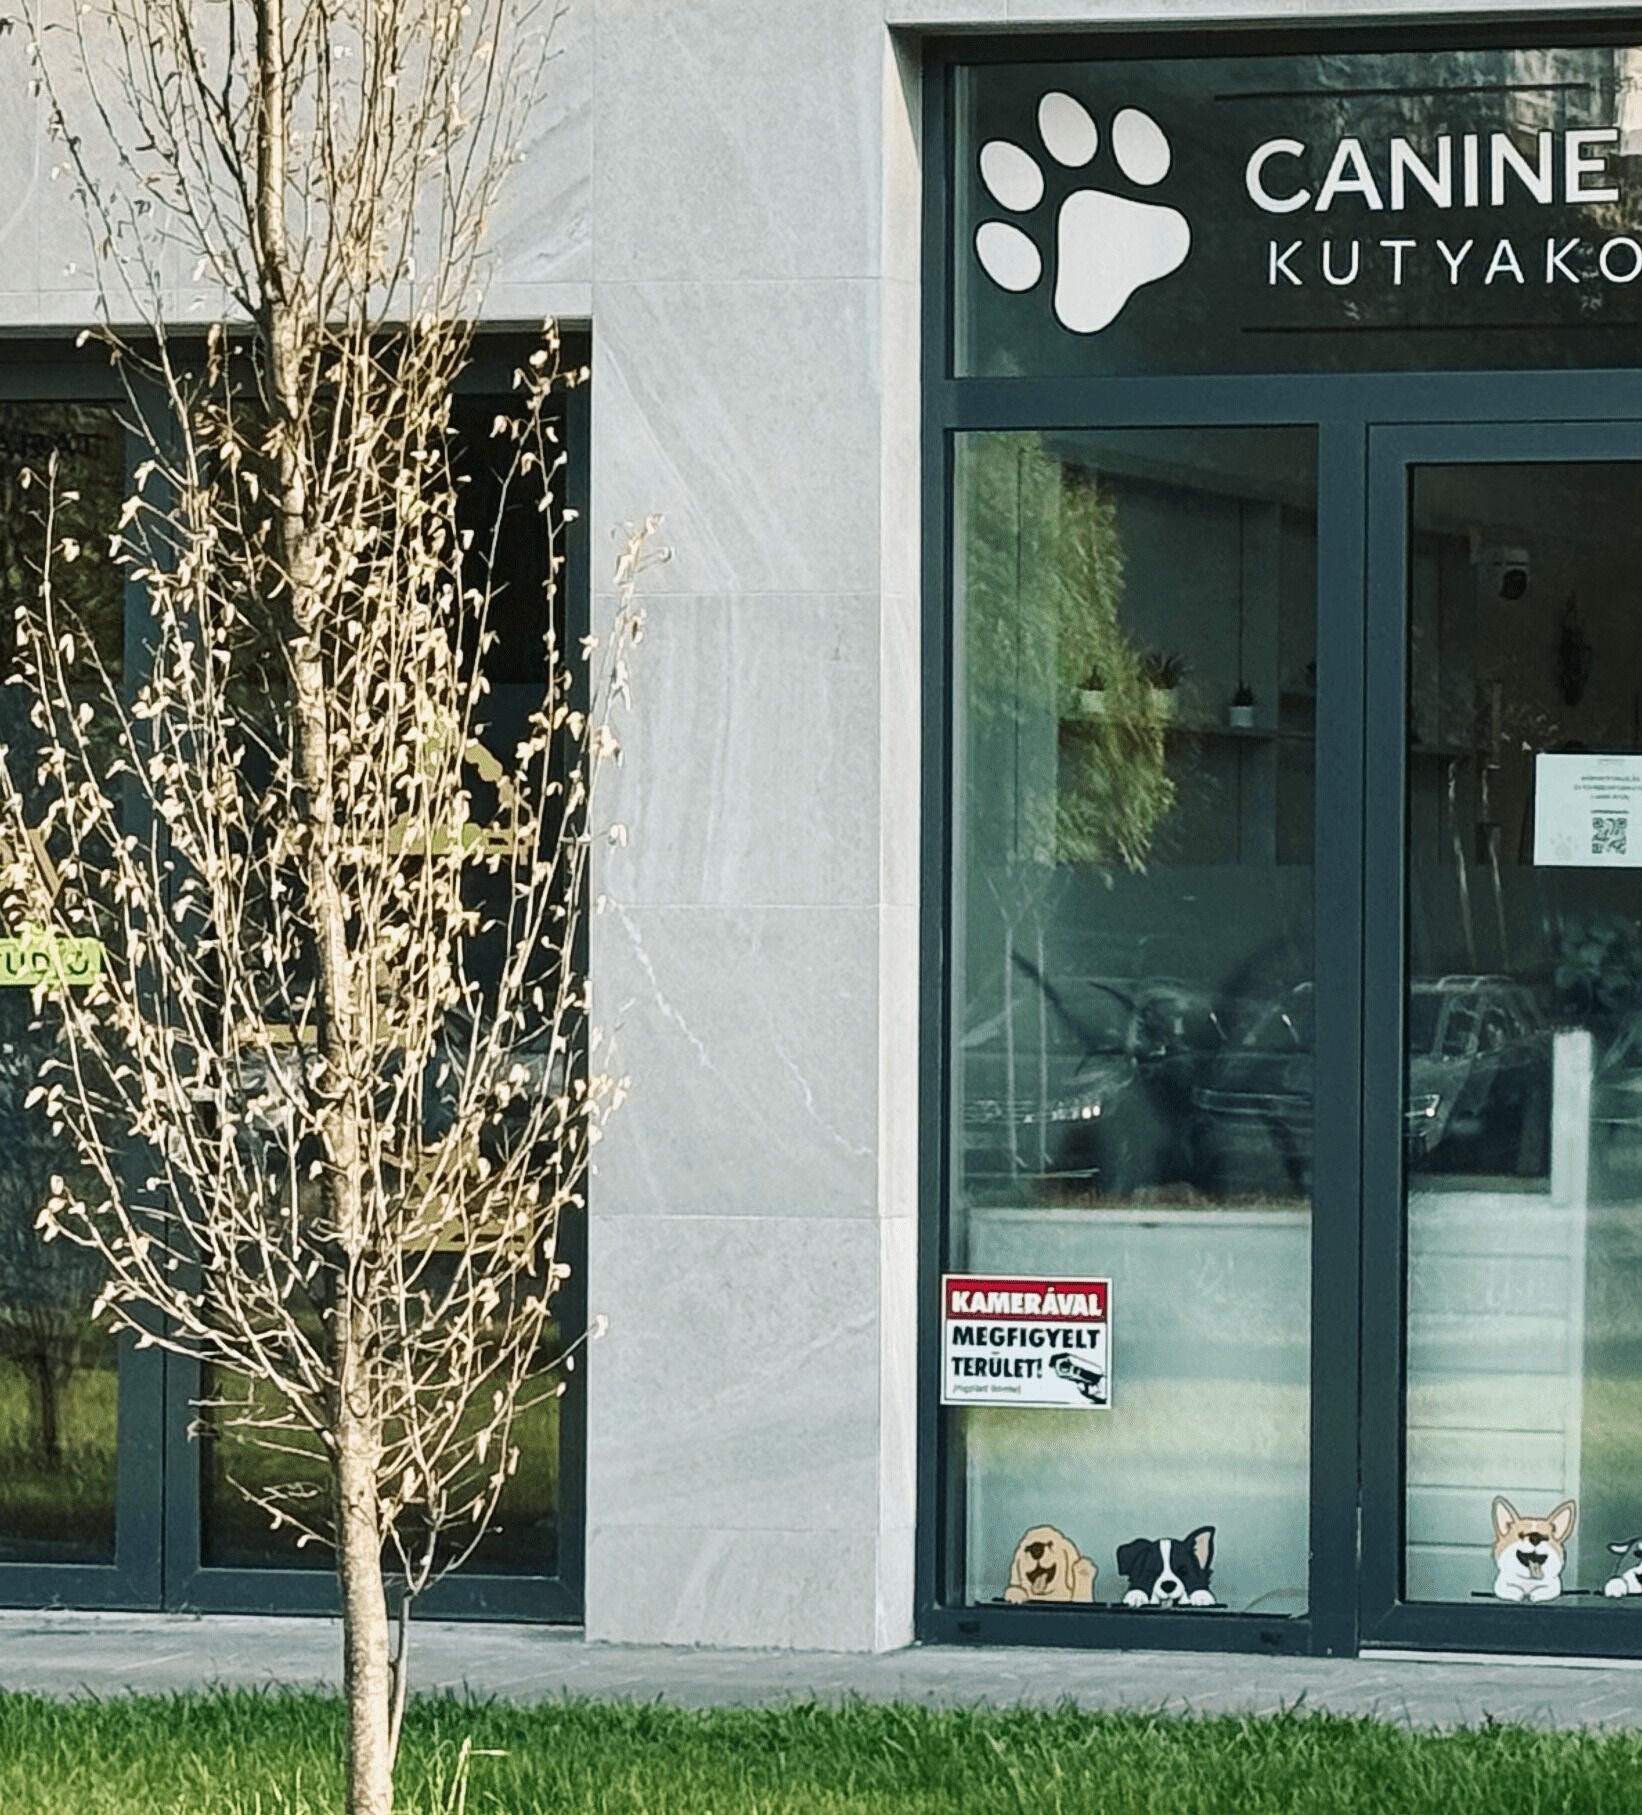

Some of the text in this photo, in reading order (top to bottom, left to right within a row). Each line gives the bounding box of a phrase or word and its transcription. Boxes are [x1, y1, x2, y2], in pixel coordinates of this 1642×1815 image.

[1245, 128, 1620, 213] CANINE
[951, 1287, 1103, 1317] KAMERÁVAL
[951, 1325, 1101, 1349] MEGFIGYELT
[951, 1351, 1043, 1379] TERÜLET!
